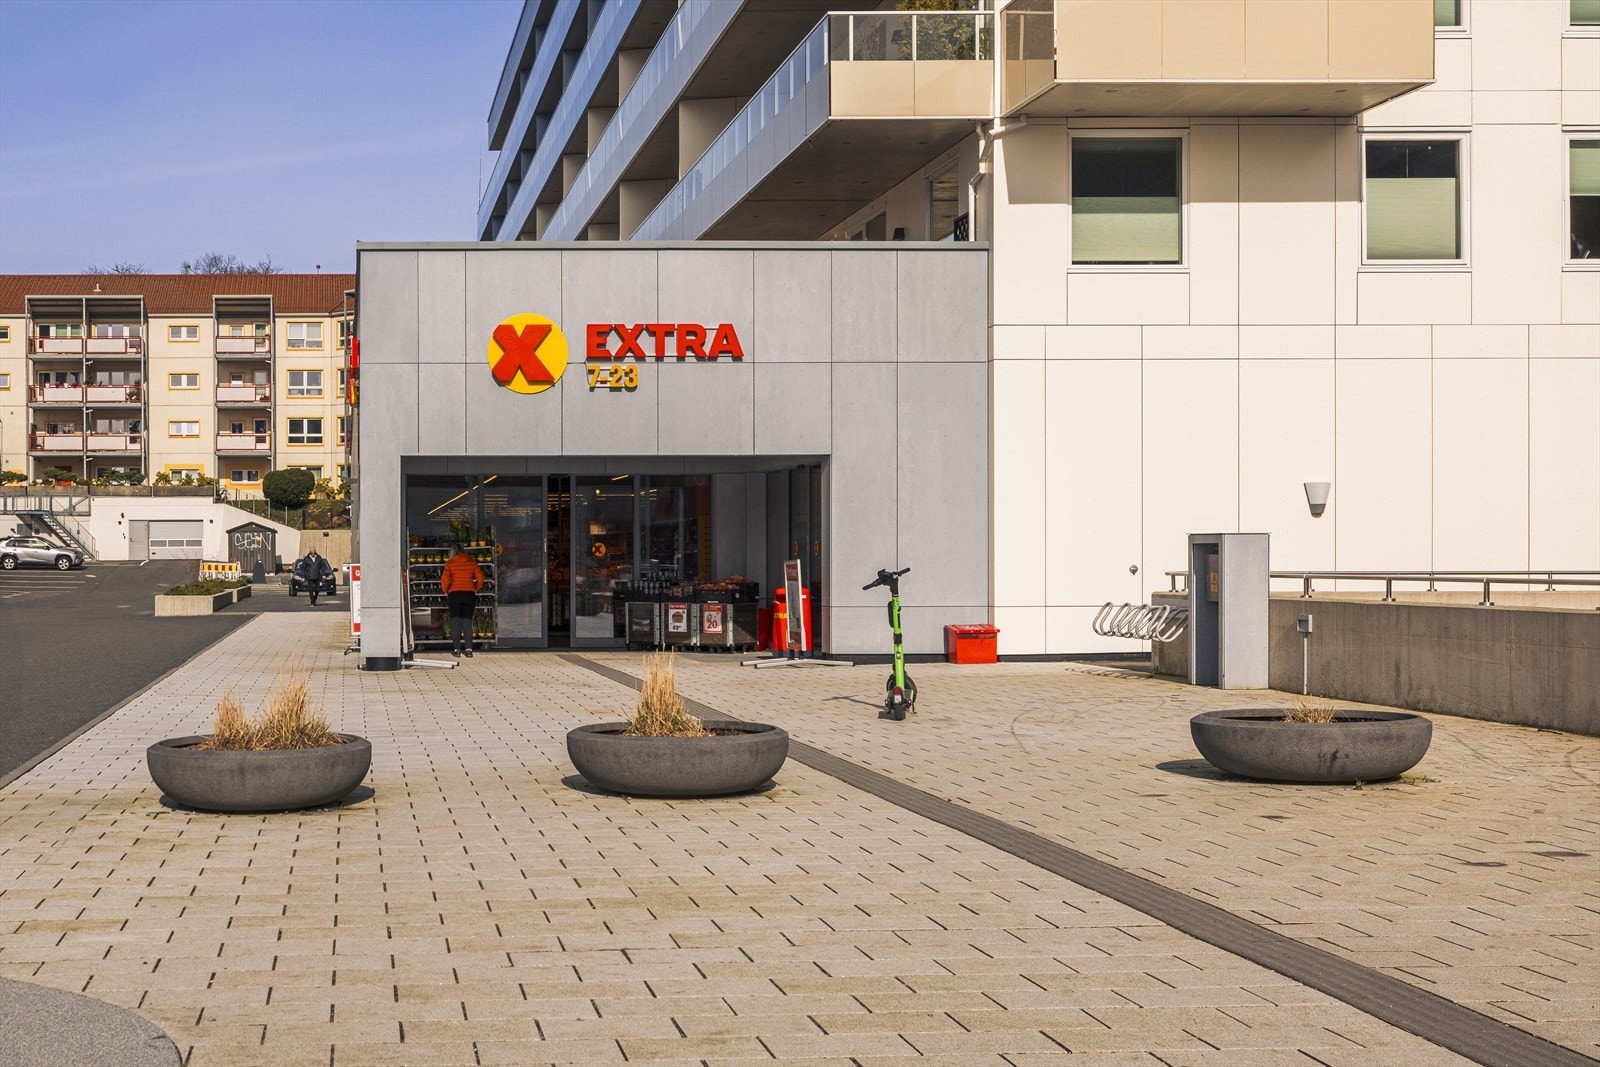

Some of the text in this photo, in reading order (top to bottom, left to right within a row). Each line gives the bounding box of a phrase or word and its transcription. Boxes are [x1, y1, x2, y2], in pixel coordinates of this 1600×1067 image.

[492, 323, 556, 381] X
[586, 323, 744, 357] EXTRA
[587, 364, 639, 387] 7-23
